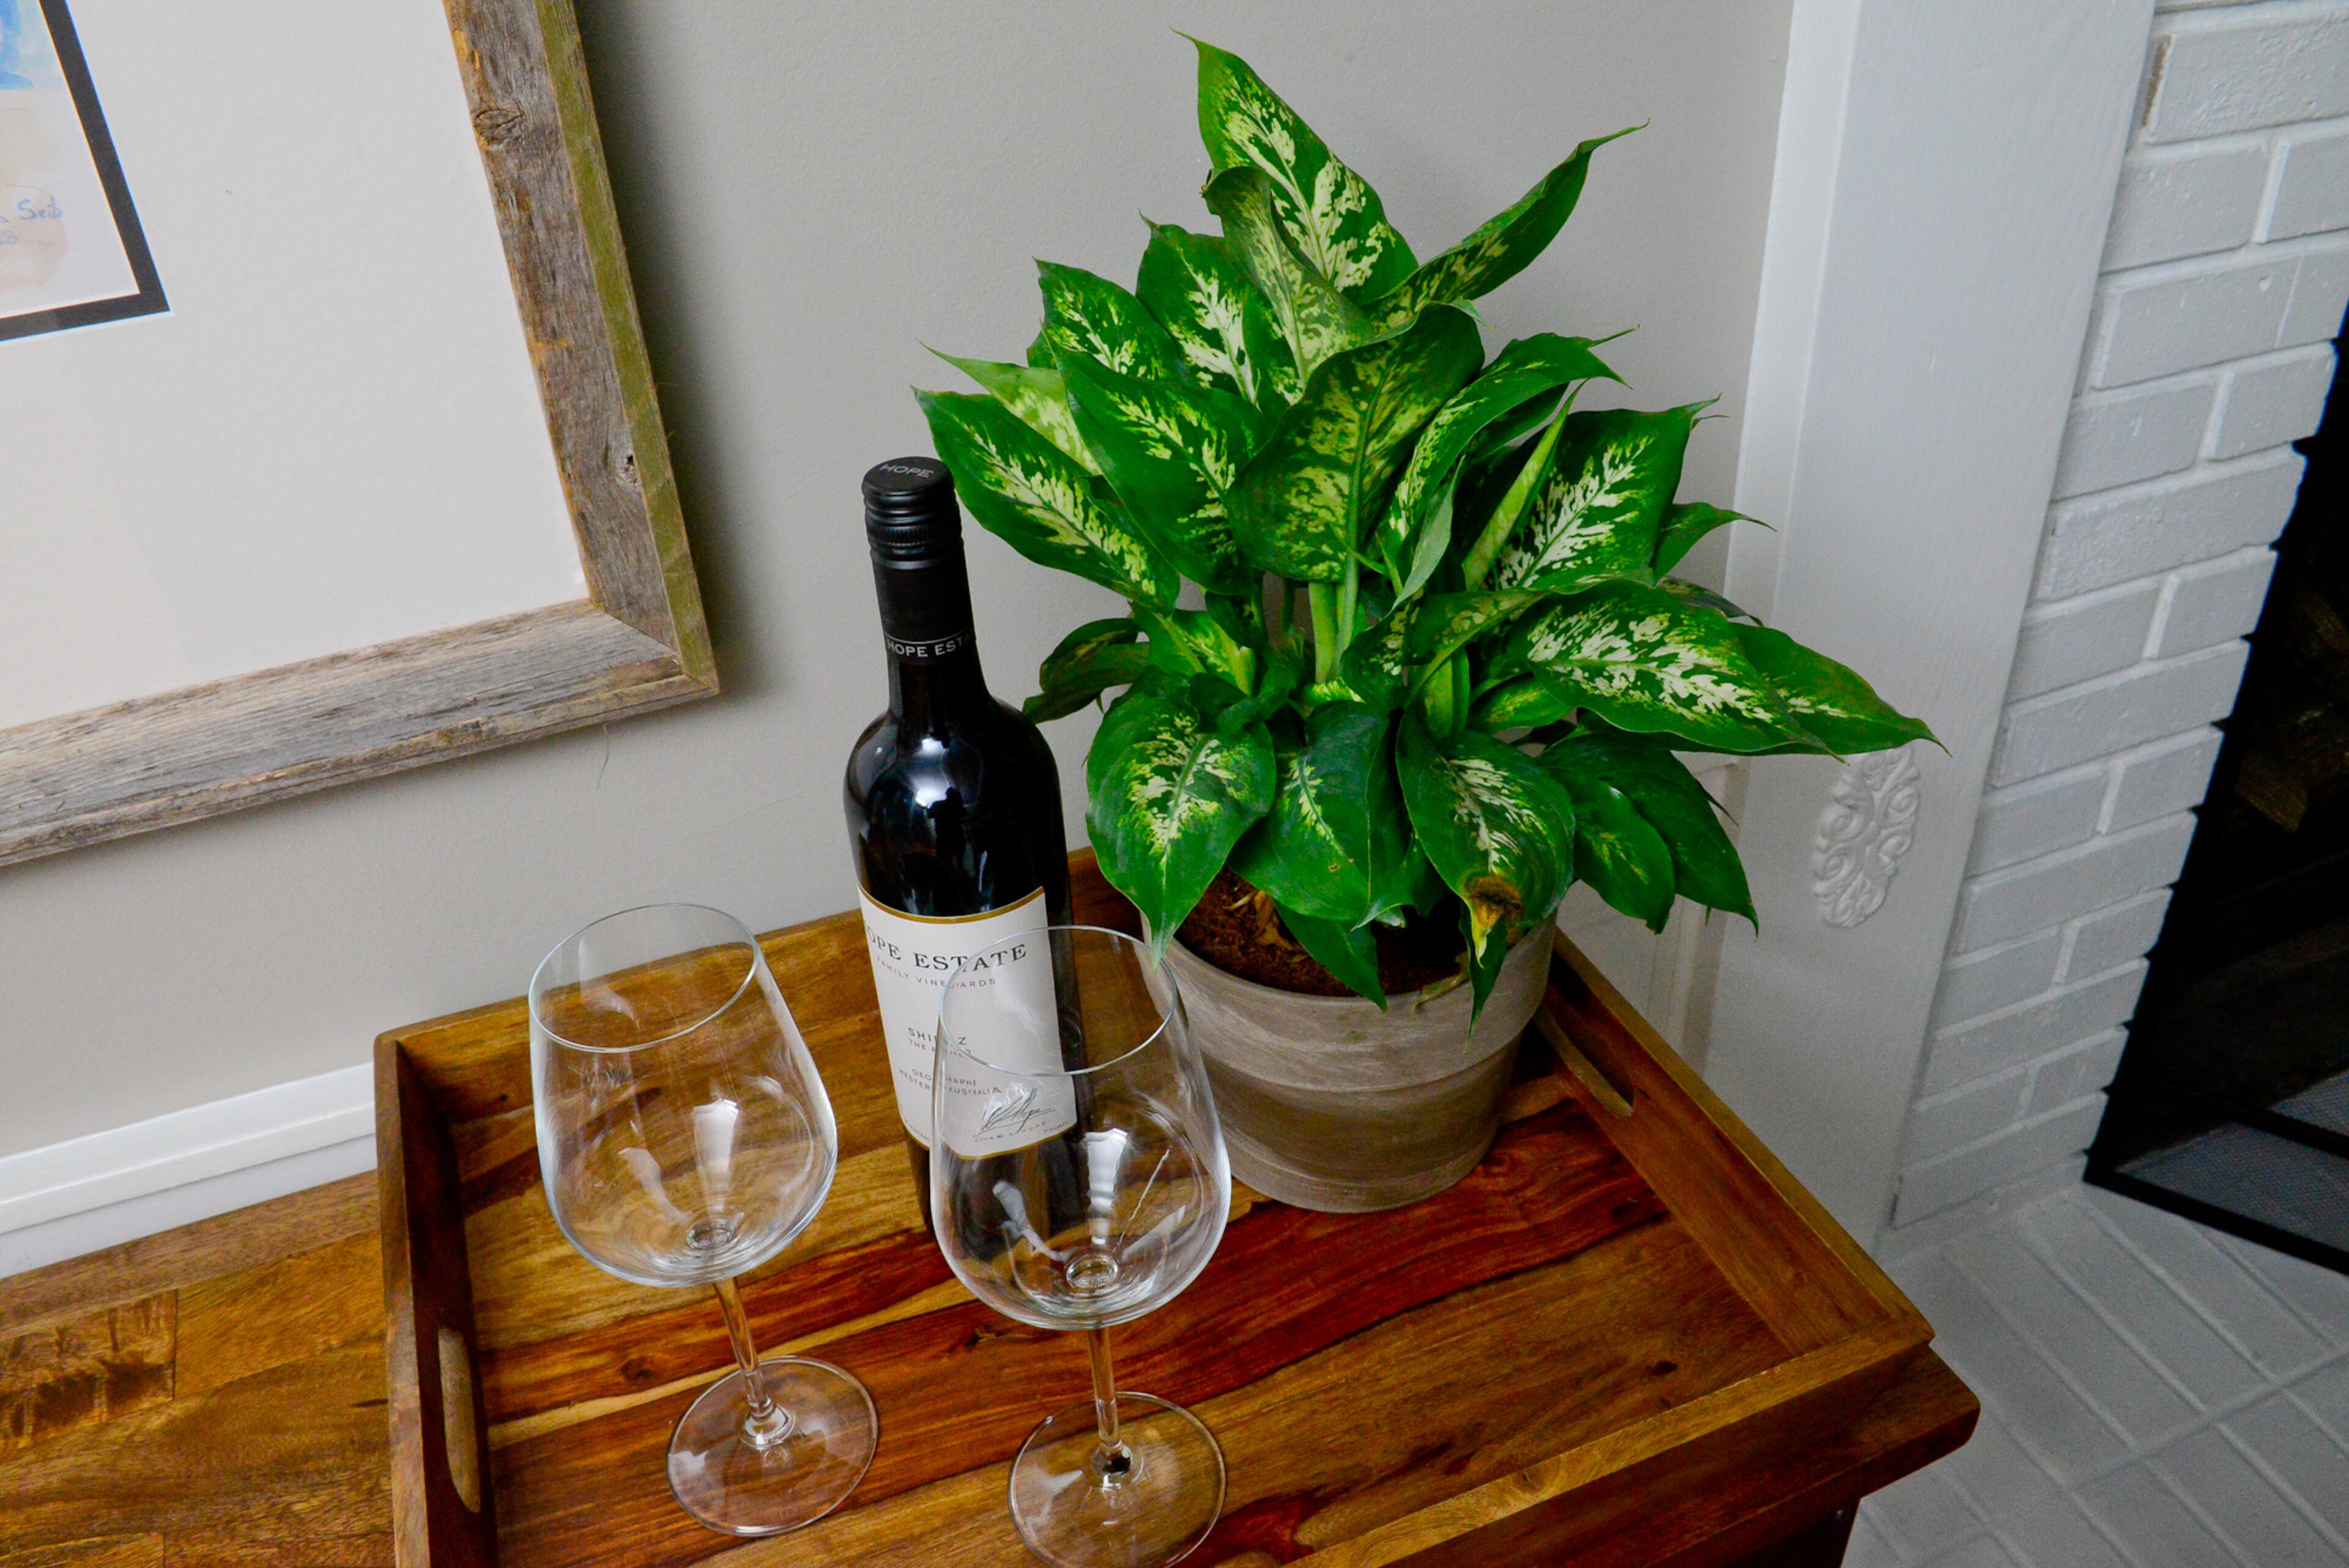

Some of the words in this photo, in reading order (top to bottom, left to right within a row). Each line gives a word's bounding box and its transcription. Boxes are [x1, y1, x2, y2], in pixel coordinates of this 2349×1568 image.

[880, 463, 934, 478] HOPE
[886, 639, 929, 658] HOPE
[867, 926, 901, 960] OPE
[913, 943, 1026, 973] ESTATE
[908, 1027, 967, 1046] SHIZ
[898, 1068, 932, 1090] WESTER
[912, 1068, 977, 1087] GEORAPHE
